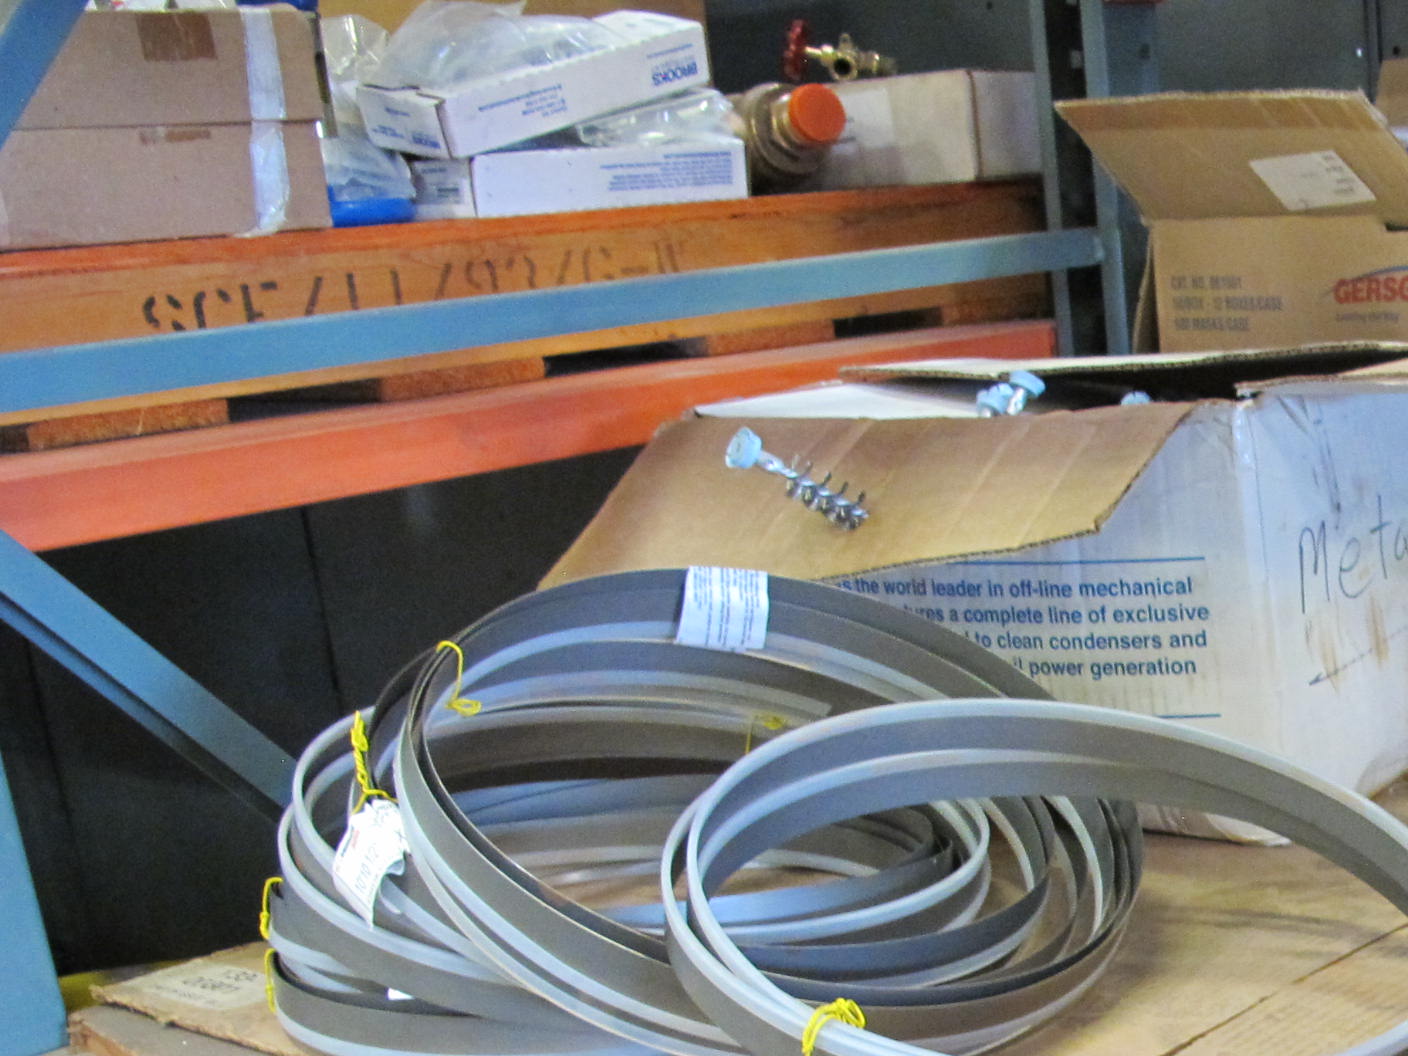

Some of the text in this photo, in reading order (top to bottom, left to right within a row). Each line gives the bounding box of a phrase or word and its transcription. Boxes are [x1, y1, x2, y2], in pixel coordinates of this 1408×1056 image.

[652, 61, 698, 86] BROOKS
[854, 578, 880, 594] the
[883, 578, 927, 596] world
[931, 579, 982, 597] leader
[988, 579, 1004, 596] in
[1009, 579, 1073, 598] off-line
[1079, 577, 1193, 597] mechanical
[949, 611, 958, 622] a
[964, 605, 1044, 627] complete
[1049, 606, 1082, 624] line
[1088, 605, 1106, 624] of
[1113, 603, 1210, 624] exclusive
[975, 630, 1207, 650] to clean condensers and
[1029, 660, 1085, 678] power
[1090, 656, 1197, 681] generation
